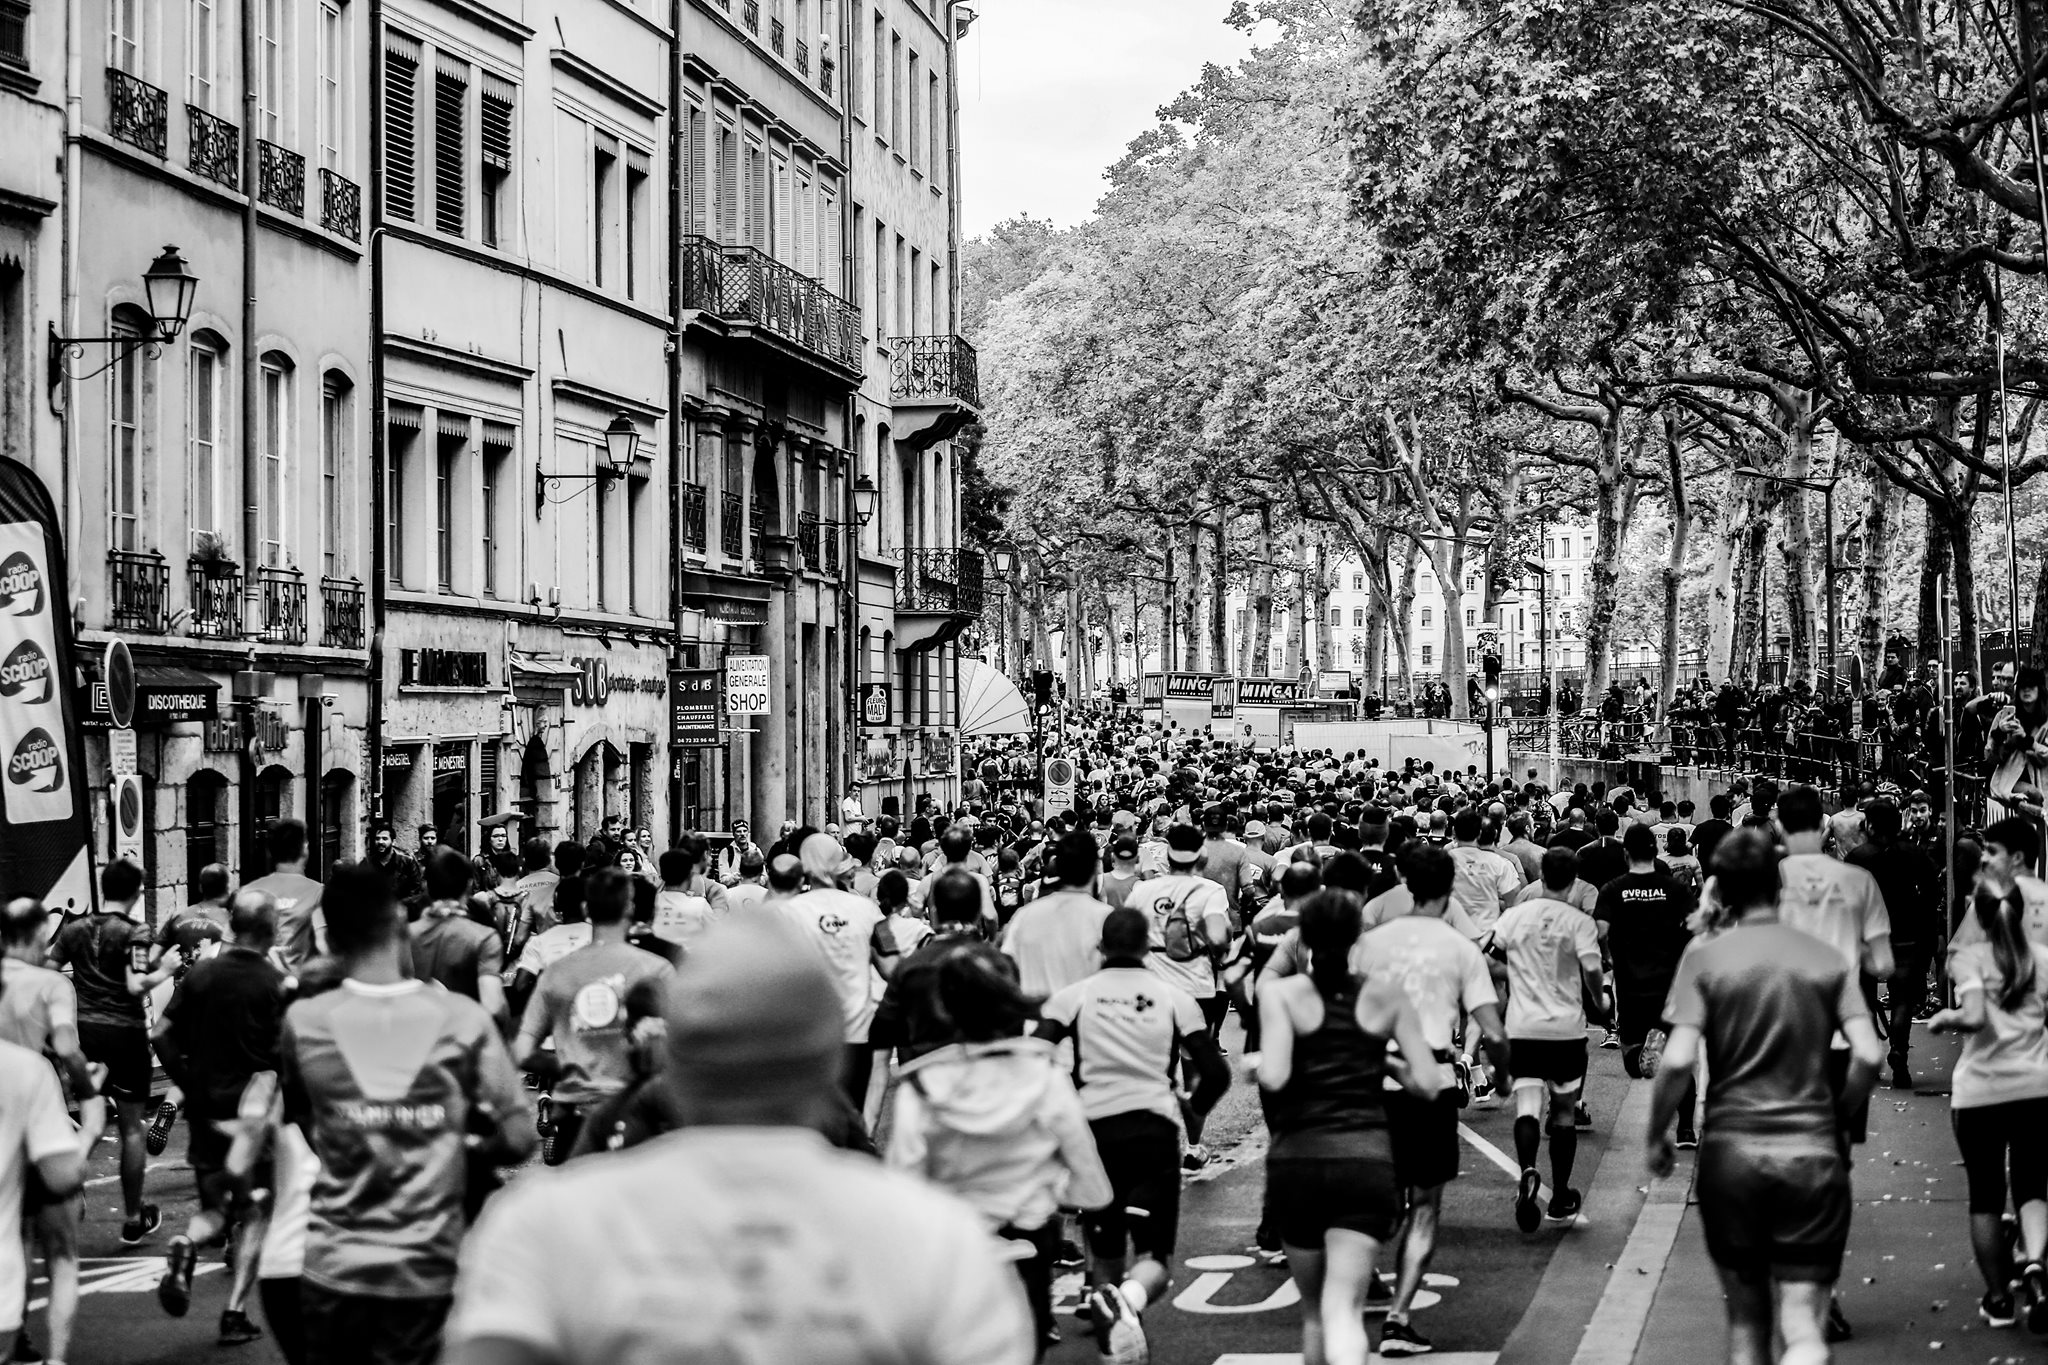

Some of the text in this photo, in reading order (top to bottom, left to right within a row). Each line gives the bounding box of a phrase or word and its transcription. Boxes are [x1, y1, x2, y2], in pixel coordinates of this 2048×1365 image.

[8, 563, 29, 575] radio
[0, 570, 40, 595] COOP
[18, 651, 38, 664] radio
[1, 658, 49, 685] SCOOP
[729, 659, 767, 672] ALIMENTATION
[729, 674, 767, 688] GENERALE
[1168, 678, 1213, 691] MINGA
[1240, 684, 1302, 699] MINGAT
[147, 694, 207, 710] DISCOTHEQUE
[730, 692, 767, 711] SHOP
[866, 697, 887, 706] FLEURS
[867, 703, 886, 717] MALT
[28, 739, 48, 752] radio
[12, 746, 58, 773] SCOOP
